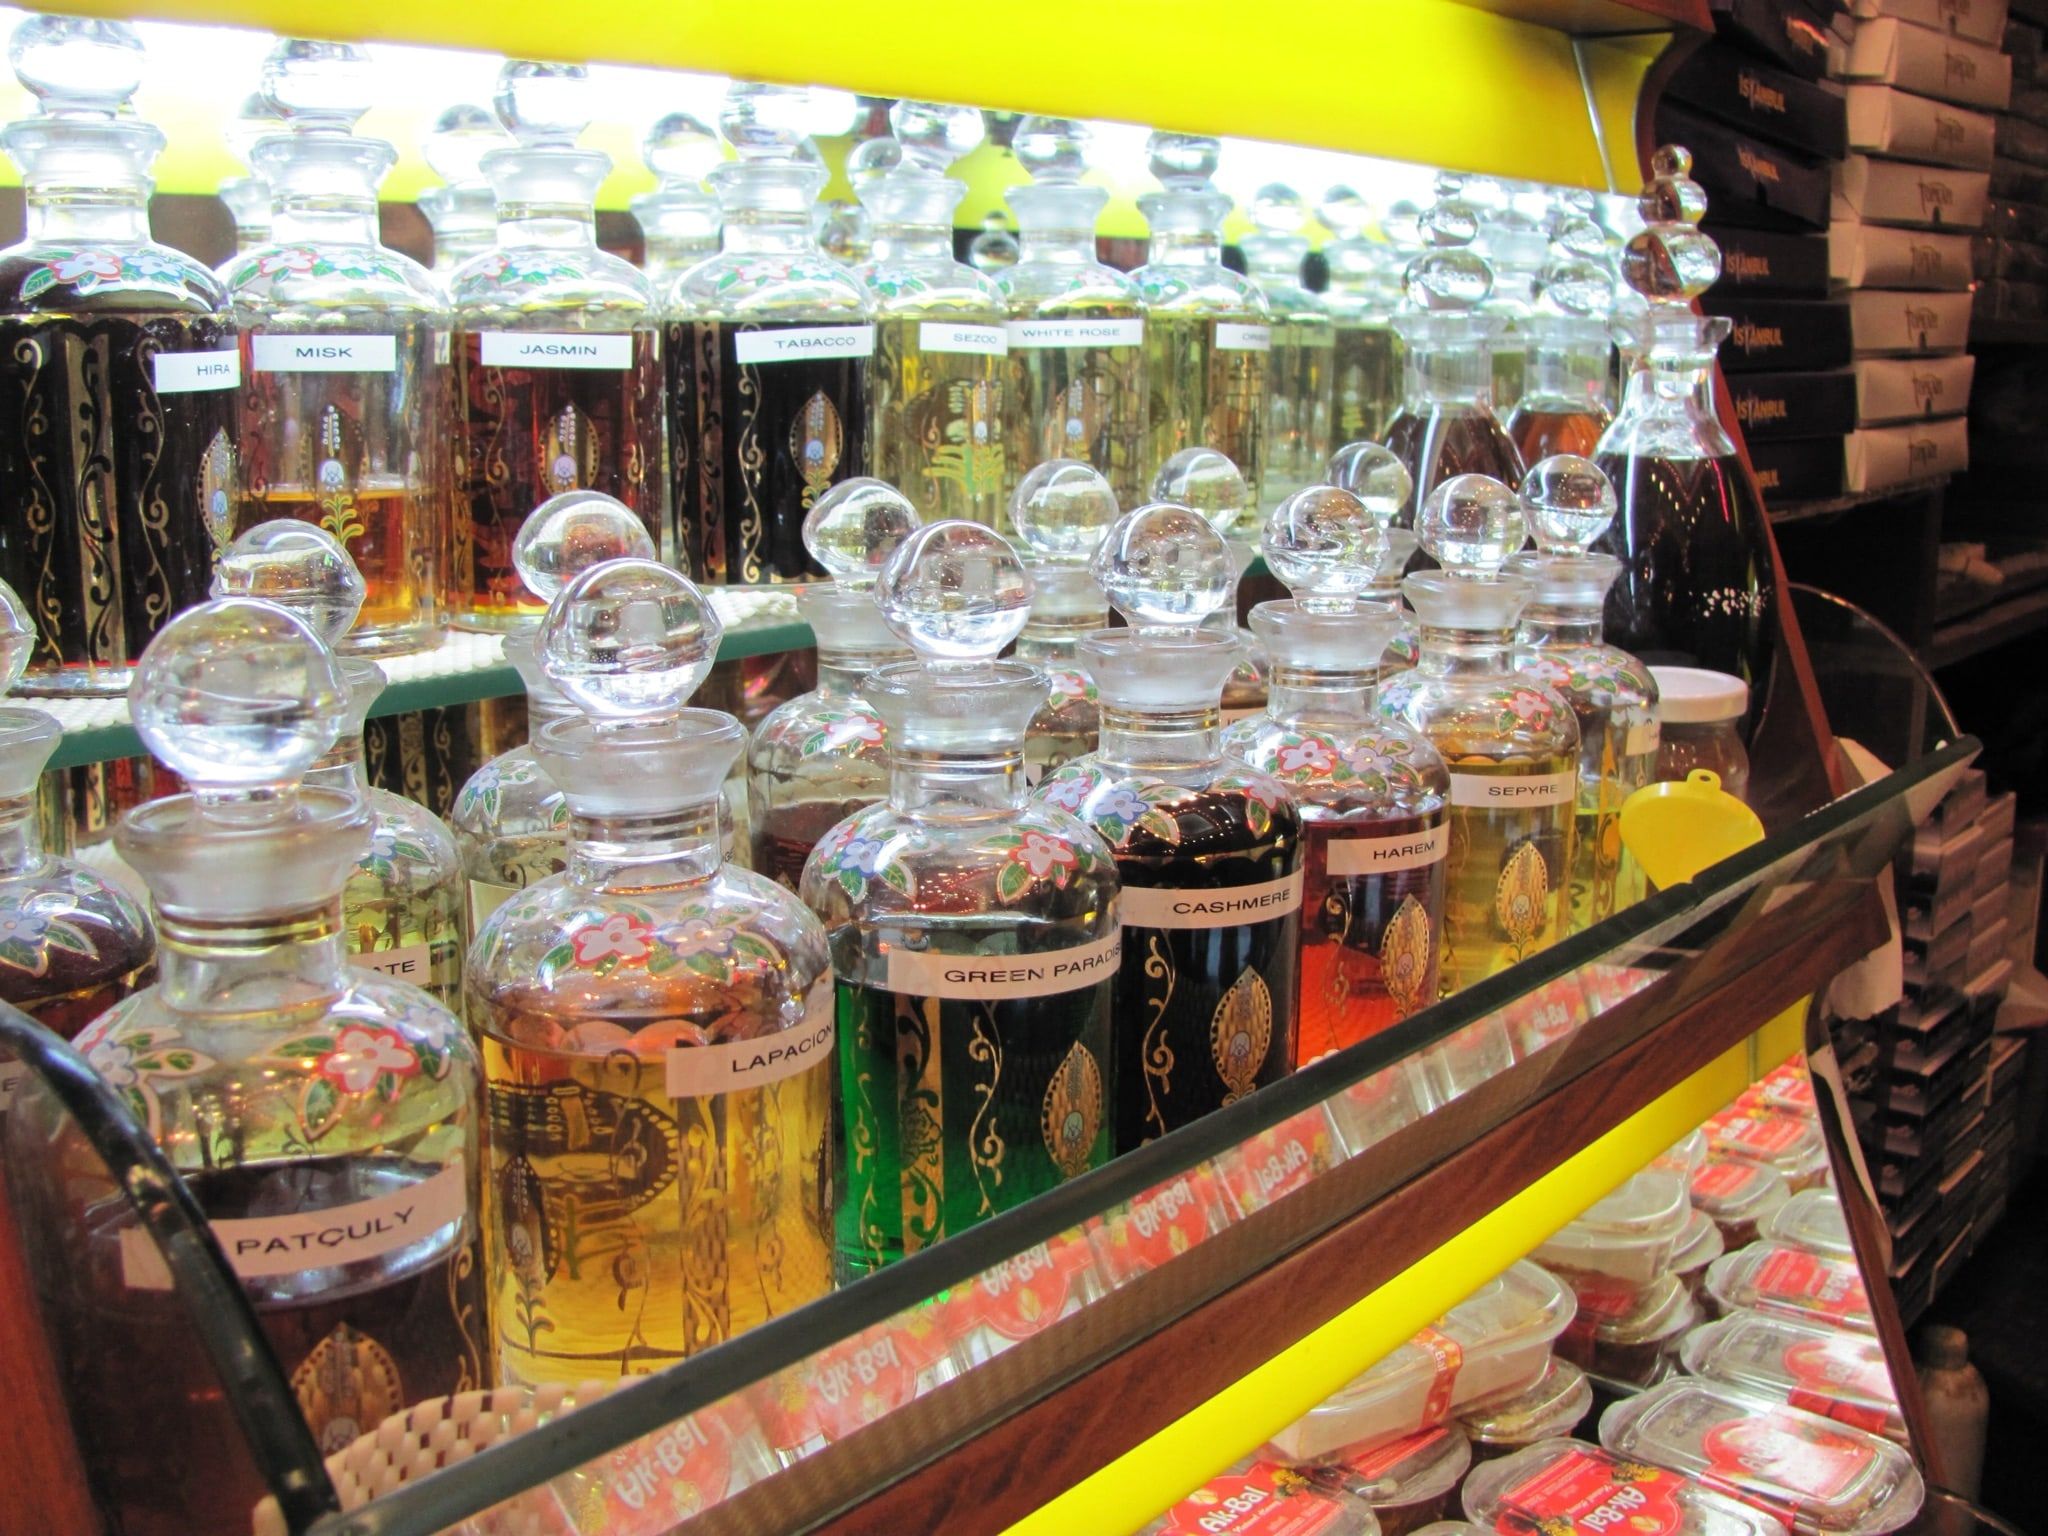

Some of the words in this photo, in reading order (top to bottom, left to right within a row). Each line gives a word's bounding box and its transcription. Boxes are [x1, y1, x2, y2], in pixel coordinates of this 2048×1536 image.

[1022, 328, 1074, 338] WHITE
[1079, 328, 1121, 337] ROSE
[520, 344, 598, 356] JASMIN
[774, 336, 857, 350] TABACCO
[295, 347, 353, 358] MISK
[196, 363, 231, 377] HIRA
[1488, 783, 1559, 797] SEPYRE
[1373, 841, 1436, 861] HAREM
[1172, 888, 1292, 915] CASHMERE
[372, 959, 416, 976] TE
[943, 966, 1045, 983] GREEN
[731, 1020, 833, 1074] LAPACION
[1198, 1485, 1270, 1532] Ak-Bal
[1578, 1486, 1647, 1533] Ak-Bal
